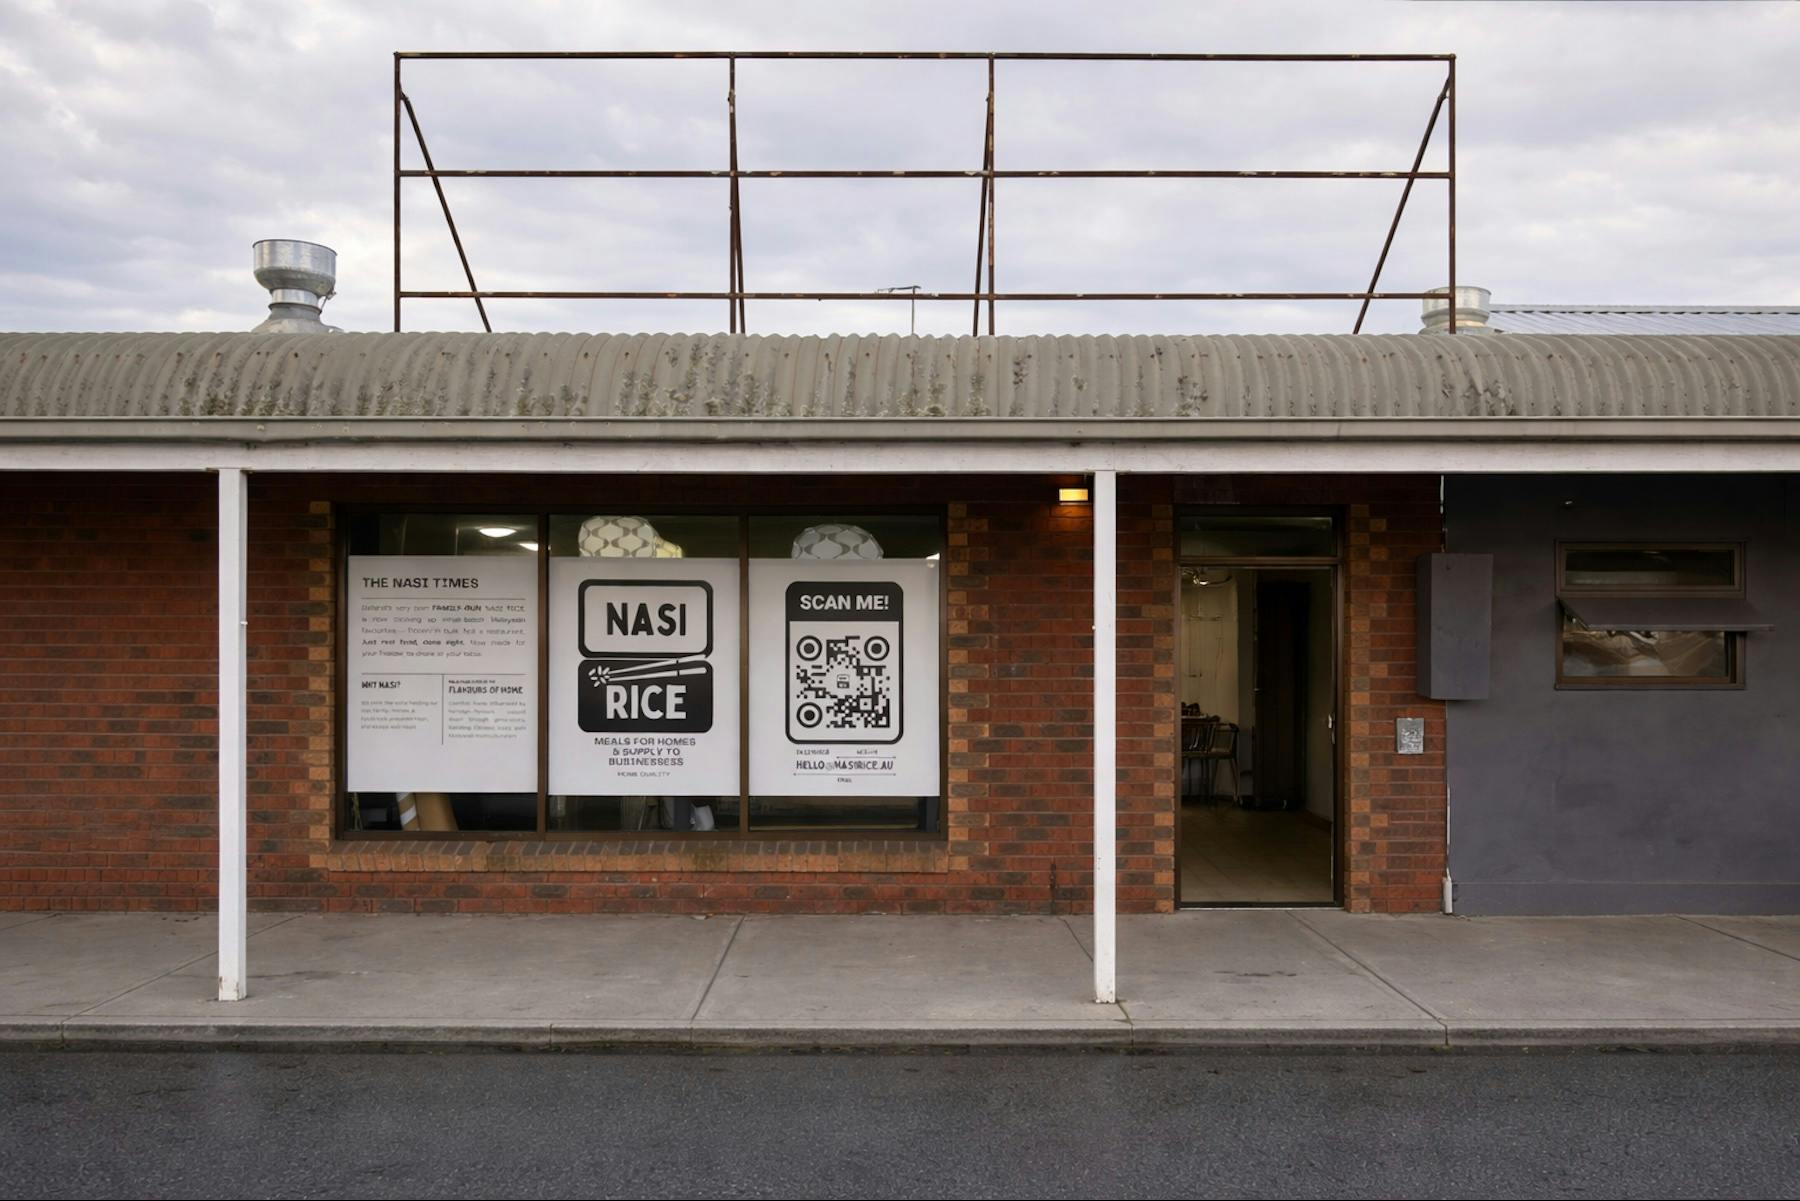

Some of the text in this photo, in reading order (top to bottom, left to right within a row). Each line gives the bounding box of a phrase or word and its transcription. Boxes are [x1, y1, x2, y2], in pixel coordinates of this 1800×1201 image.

[362, 577, 479, 589] THE NASI TIMES
[799, 594, 890, 610] SCAN ME!
[606, 602, 687, 636] NASI
[606, 684, 687, 720] RICE
[594, 737, 697, 746] MEALS FOR HOMES
[622, 747, 663, 756] SUPPLY
[666, 747, 681, 756] TO
